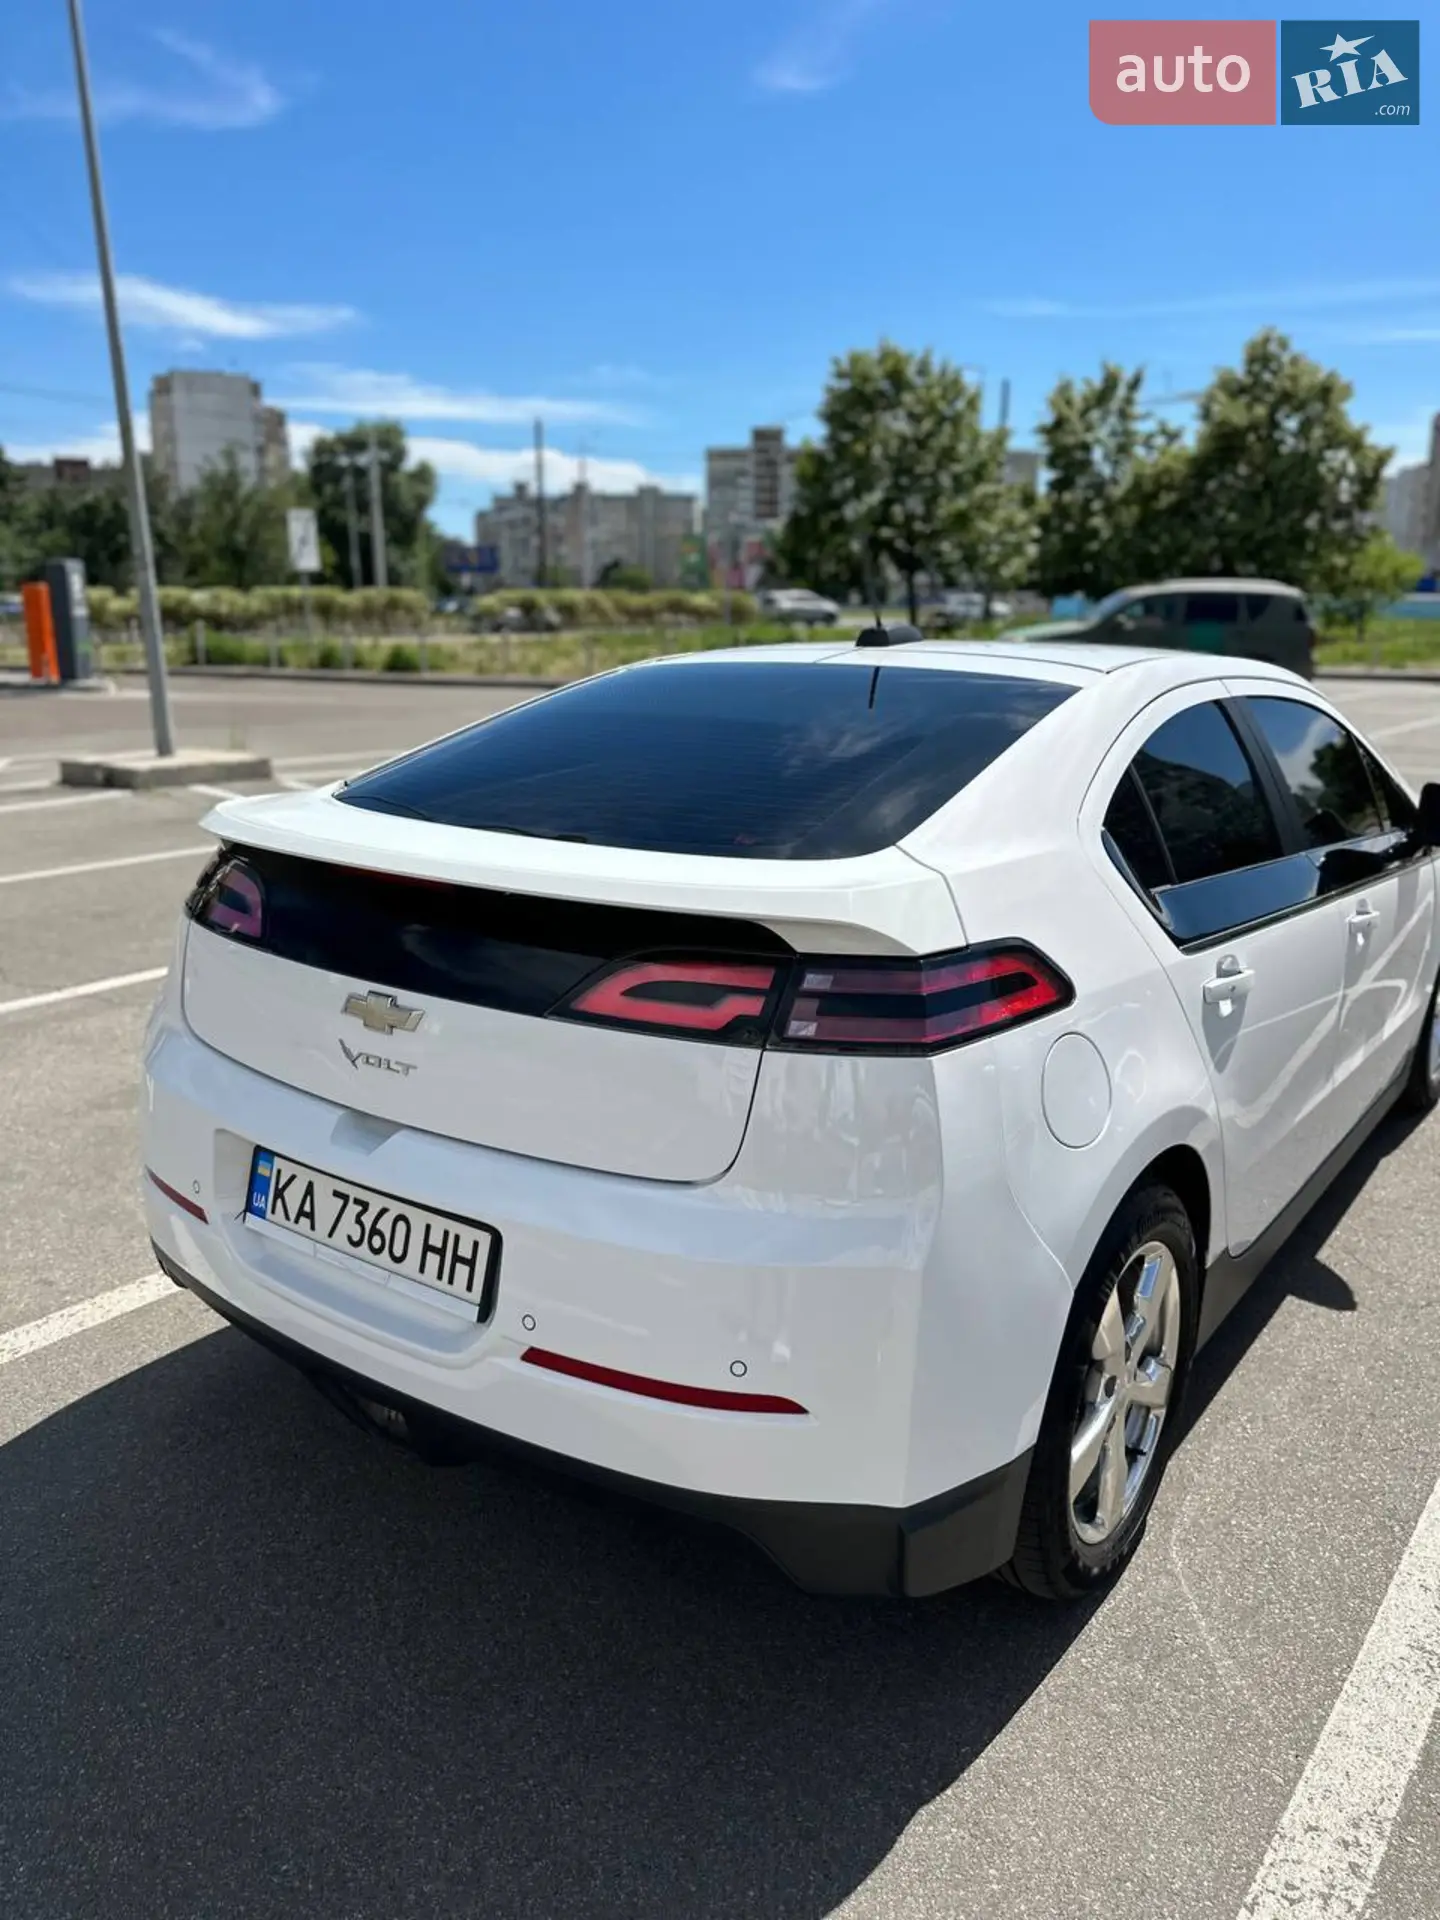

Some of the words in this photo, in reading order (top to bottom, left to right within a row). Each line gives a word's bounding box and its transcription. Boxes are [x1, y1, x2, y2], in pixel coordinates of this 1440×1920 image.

[338, 1037, 418, 1077] VOLT
[252, 1191, 266, 1210] UA
[270, 1168, 316, 1232] KA
[327, 1189, 412, 1264] 7360
[418, 1223, 480, 1293] HH
